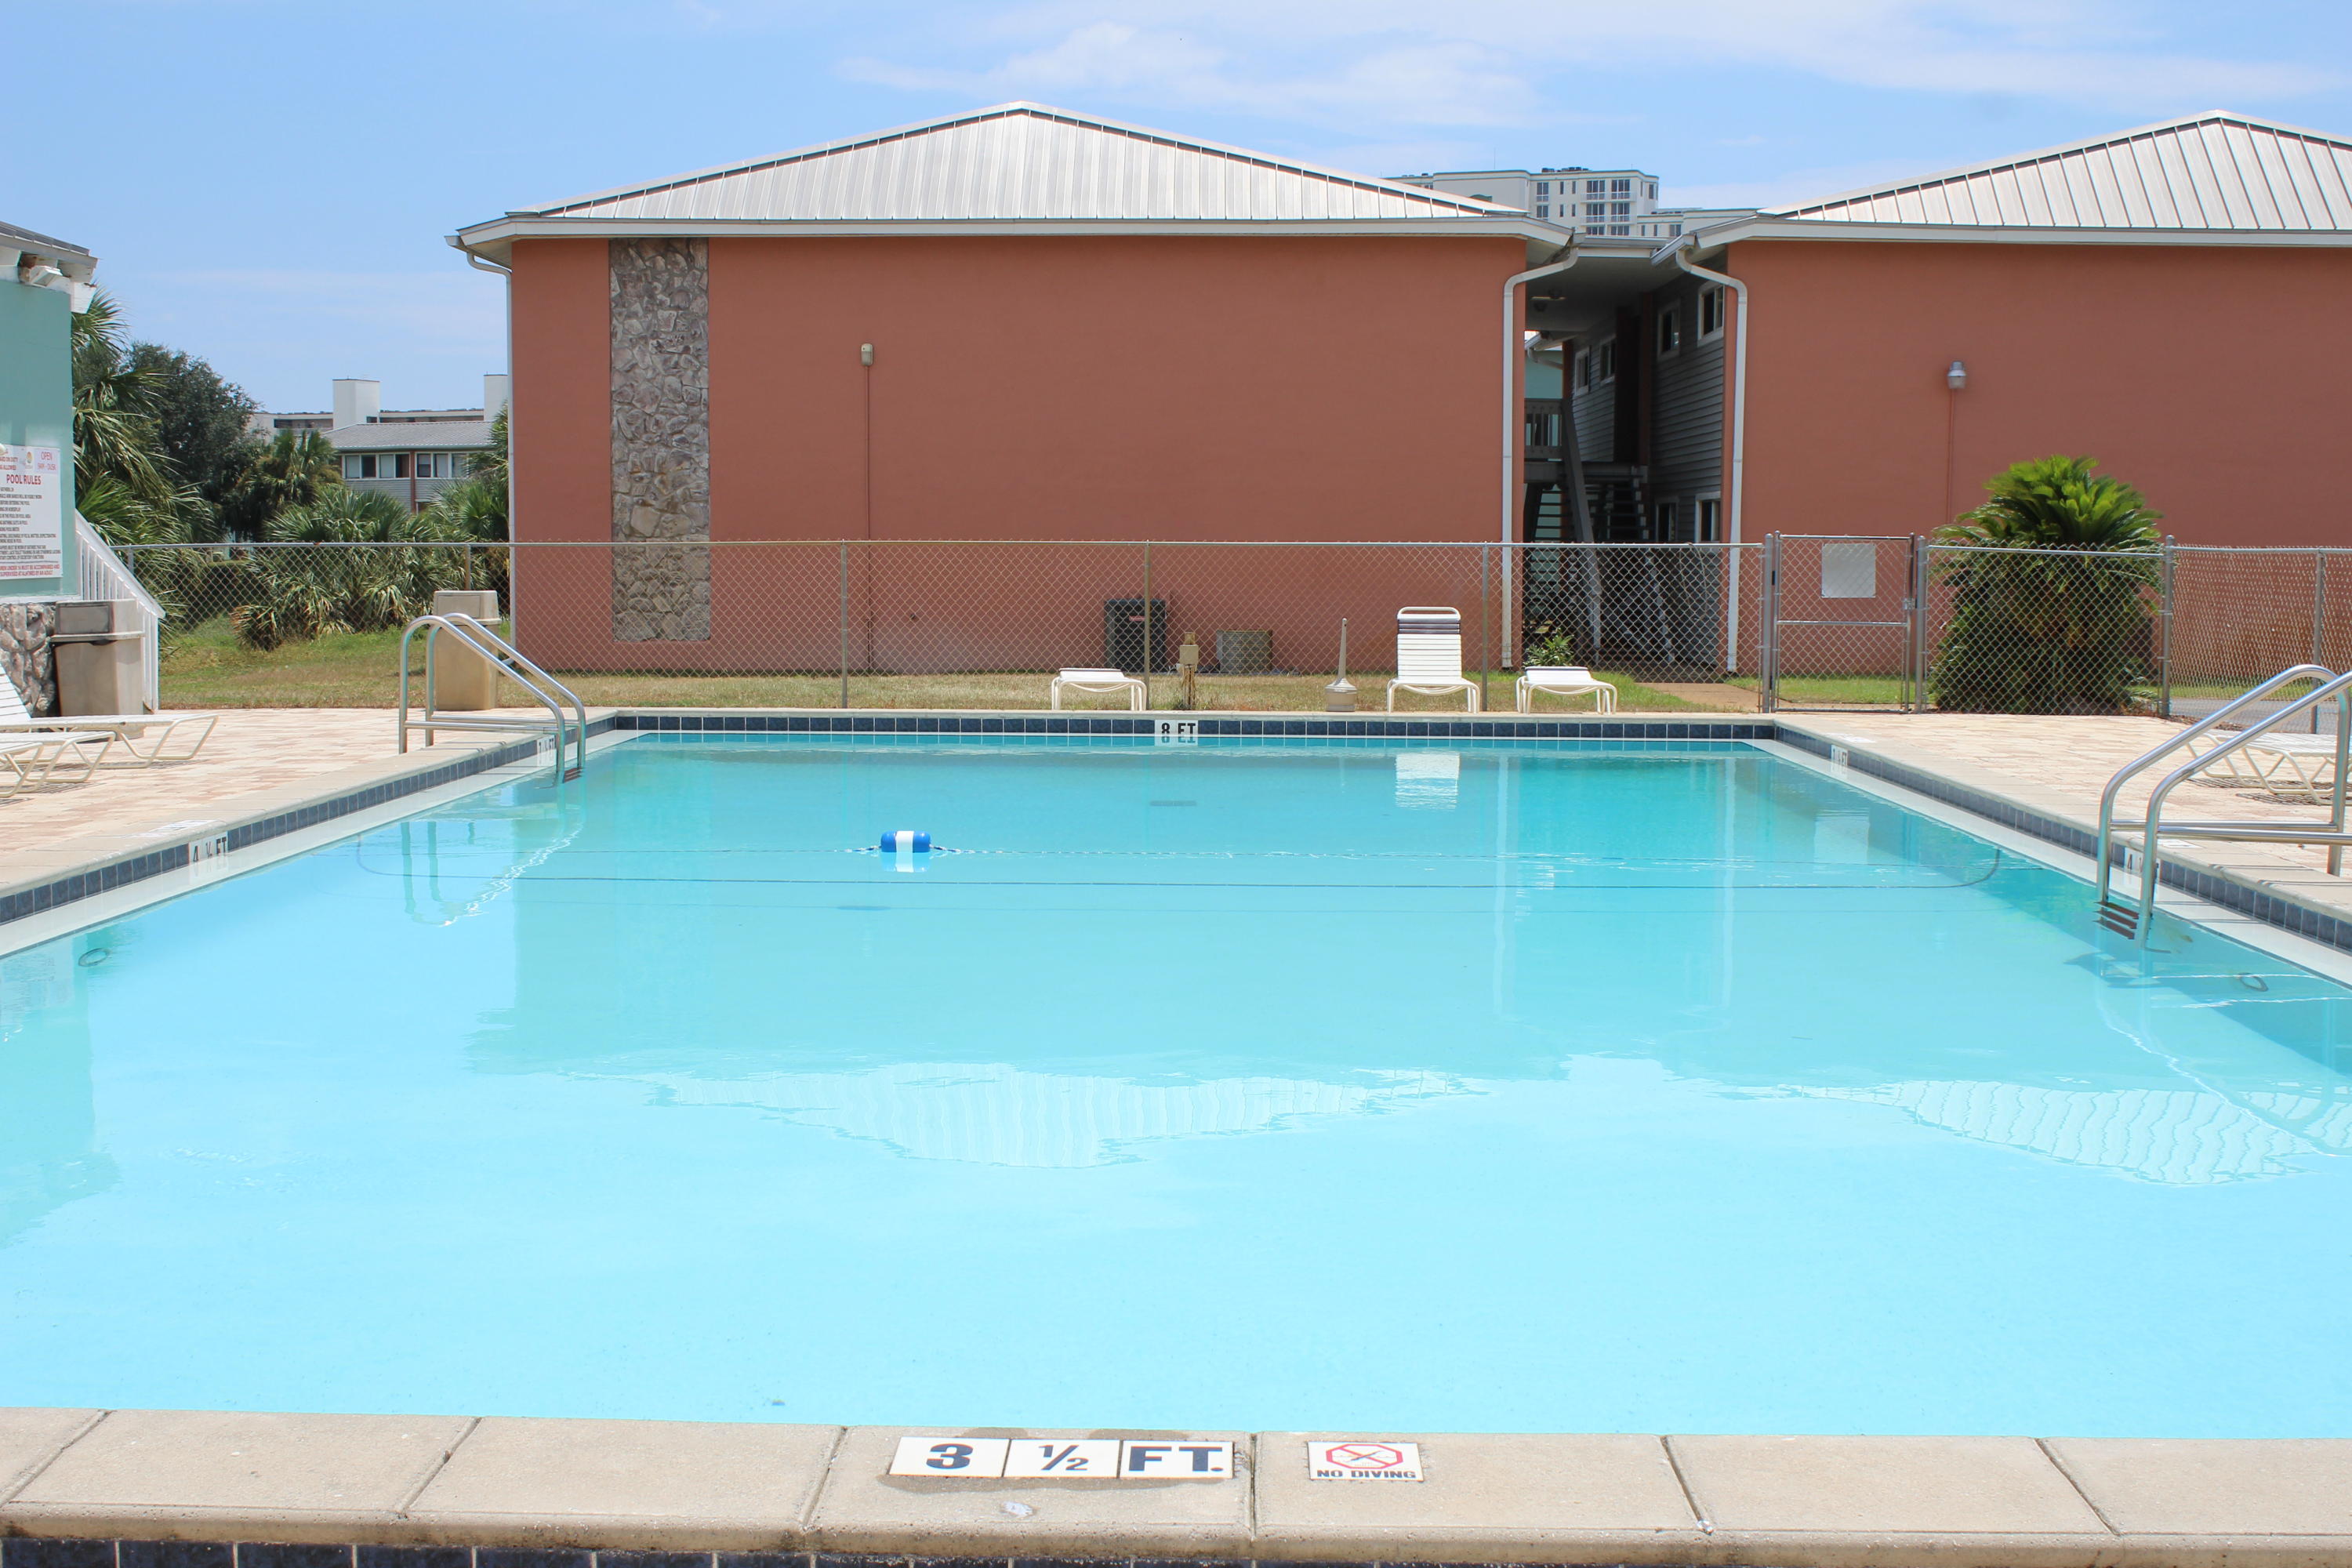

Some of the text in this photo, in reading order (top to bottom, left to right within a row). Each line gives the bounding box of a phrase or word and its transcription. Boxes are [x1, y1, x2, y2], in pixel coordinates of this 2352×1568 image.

[6, 474, 42, 485] POOL RULES
[1178, 722, 1196, 735] FT
[926, 1443, 975, 1470] 3
[1128, 1446, 1224, 1472] FT.
[1317, 1469, 1417, 1479] NO DIVING
